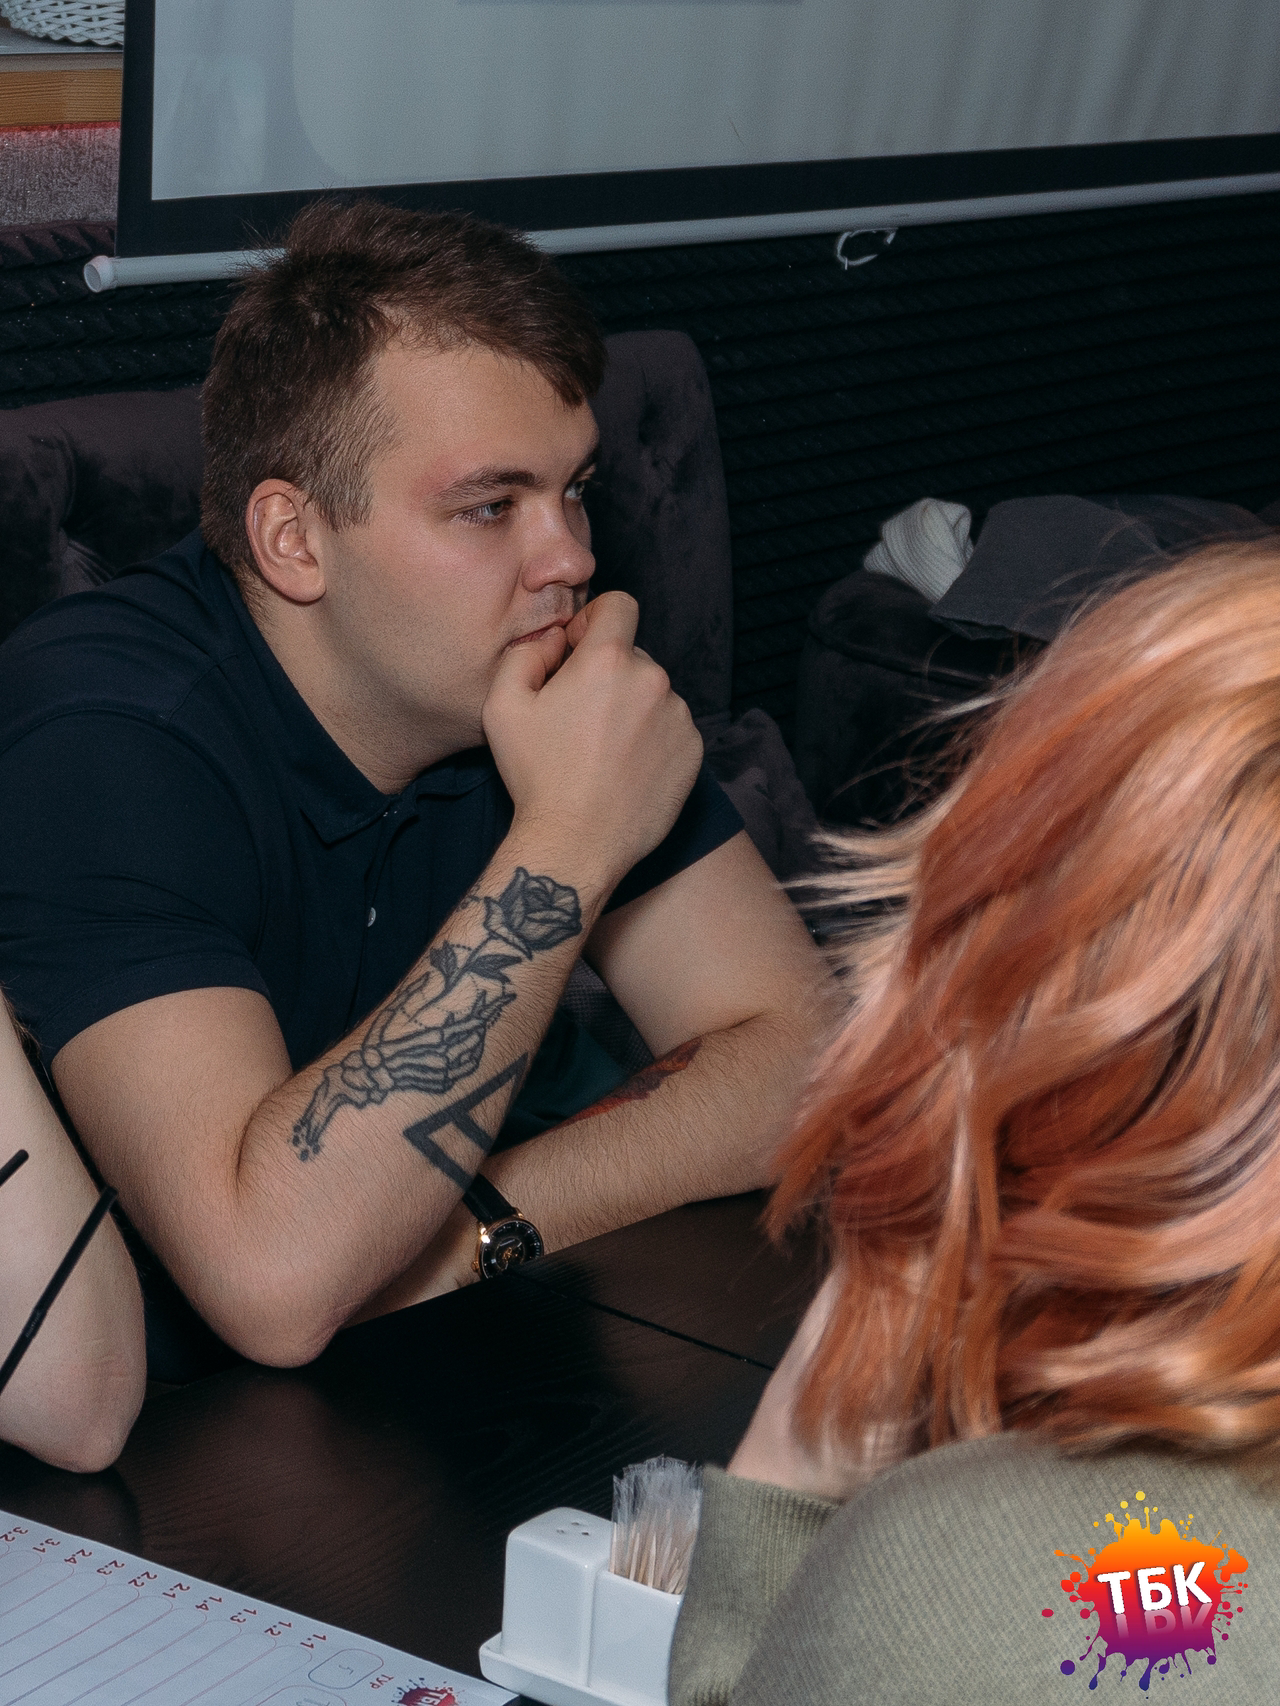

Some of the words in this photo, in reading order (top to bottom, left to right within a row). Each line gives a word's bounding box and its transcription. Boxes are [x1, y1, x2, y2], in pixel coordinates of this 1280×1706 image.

[32, 1538, 61, 1554] 3.1
[63, 1548, 93, 1565] 2.4
[96, 1559, 126, 1576] 2.3
[127, 1571, 158, 1588] 2.2
[162, 1582, 191, 1599] 2.1
[195, 1595, 223, 1612] 1.4
[229, 1608, 257, 1624] 1.3
[264, 1620, 293, 1637] 1.2
[299, 1633, 327, 1650] 1.1
